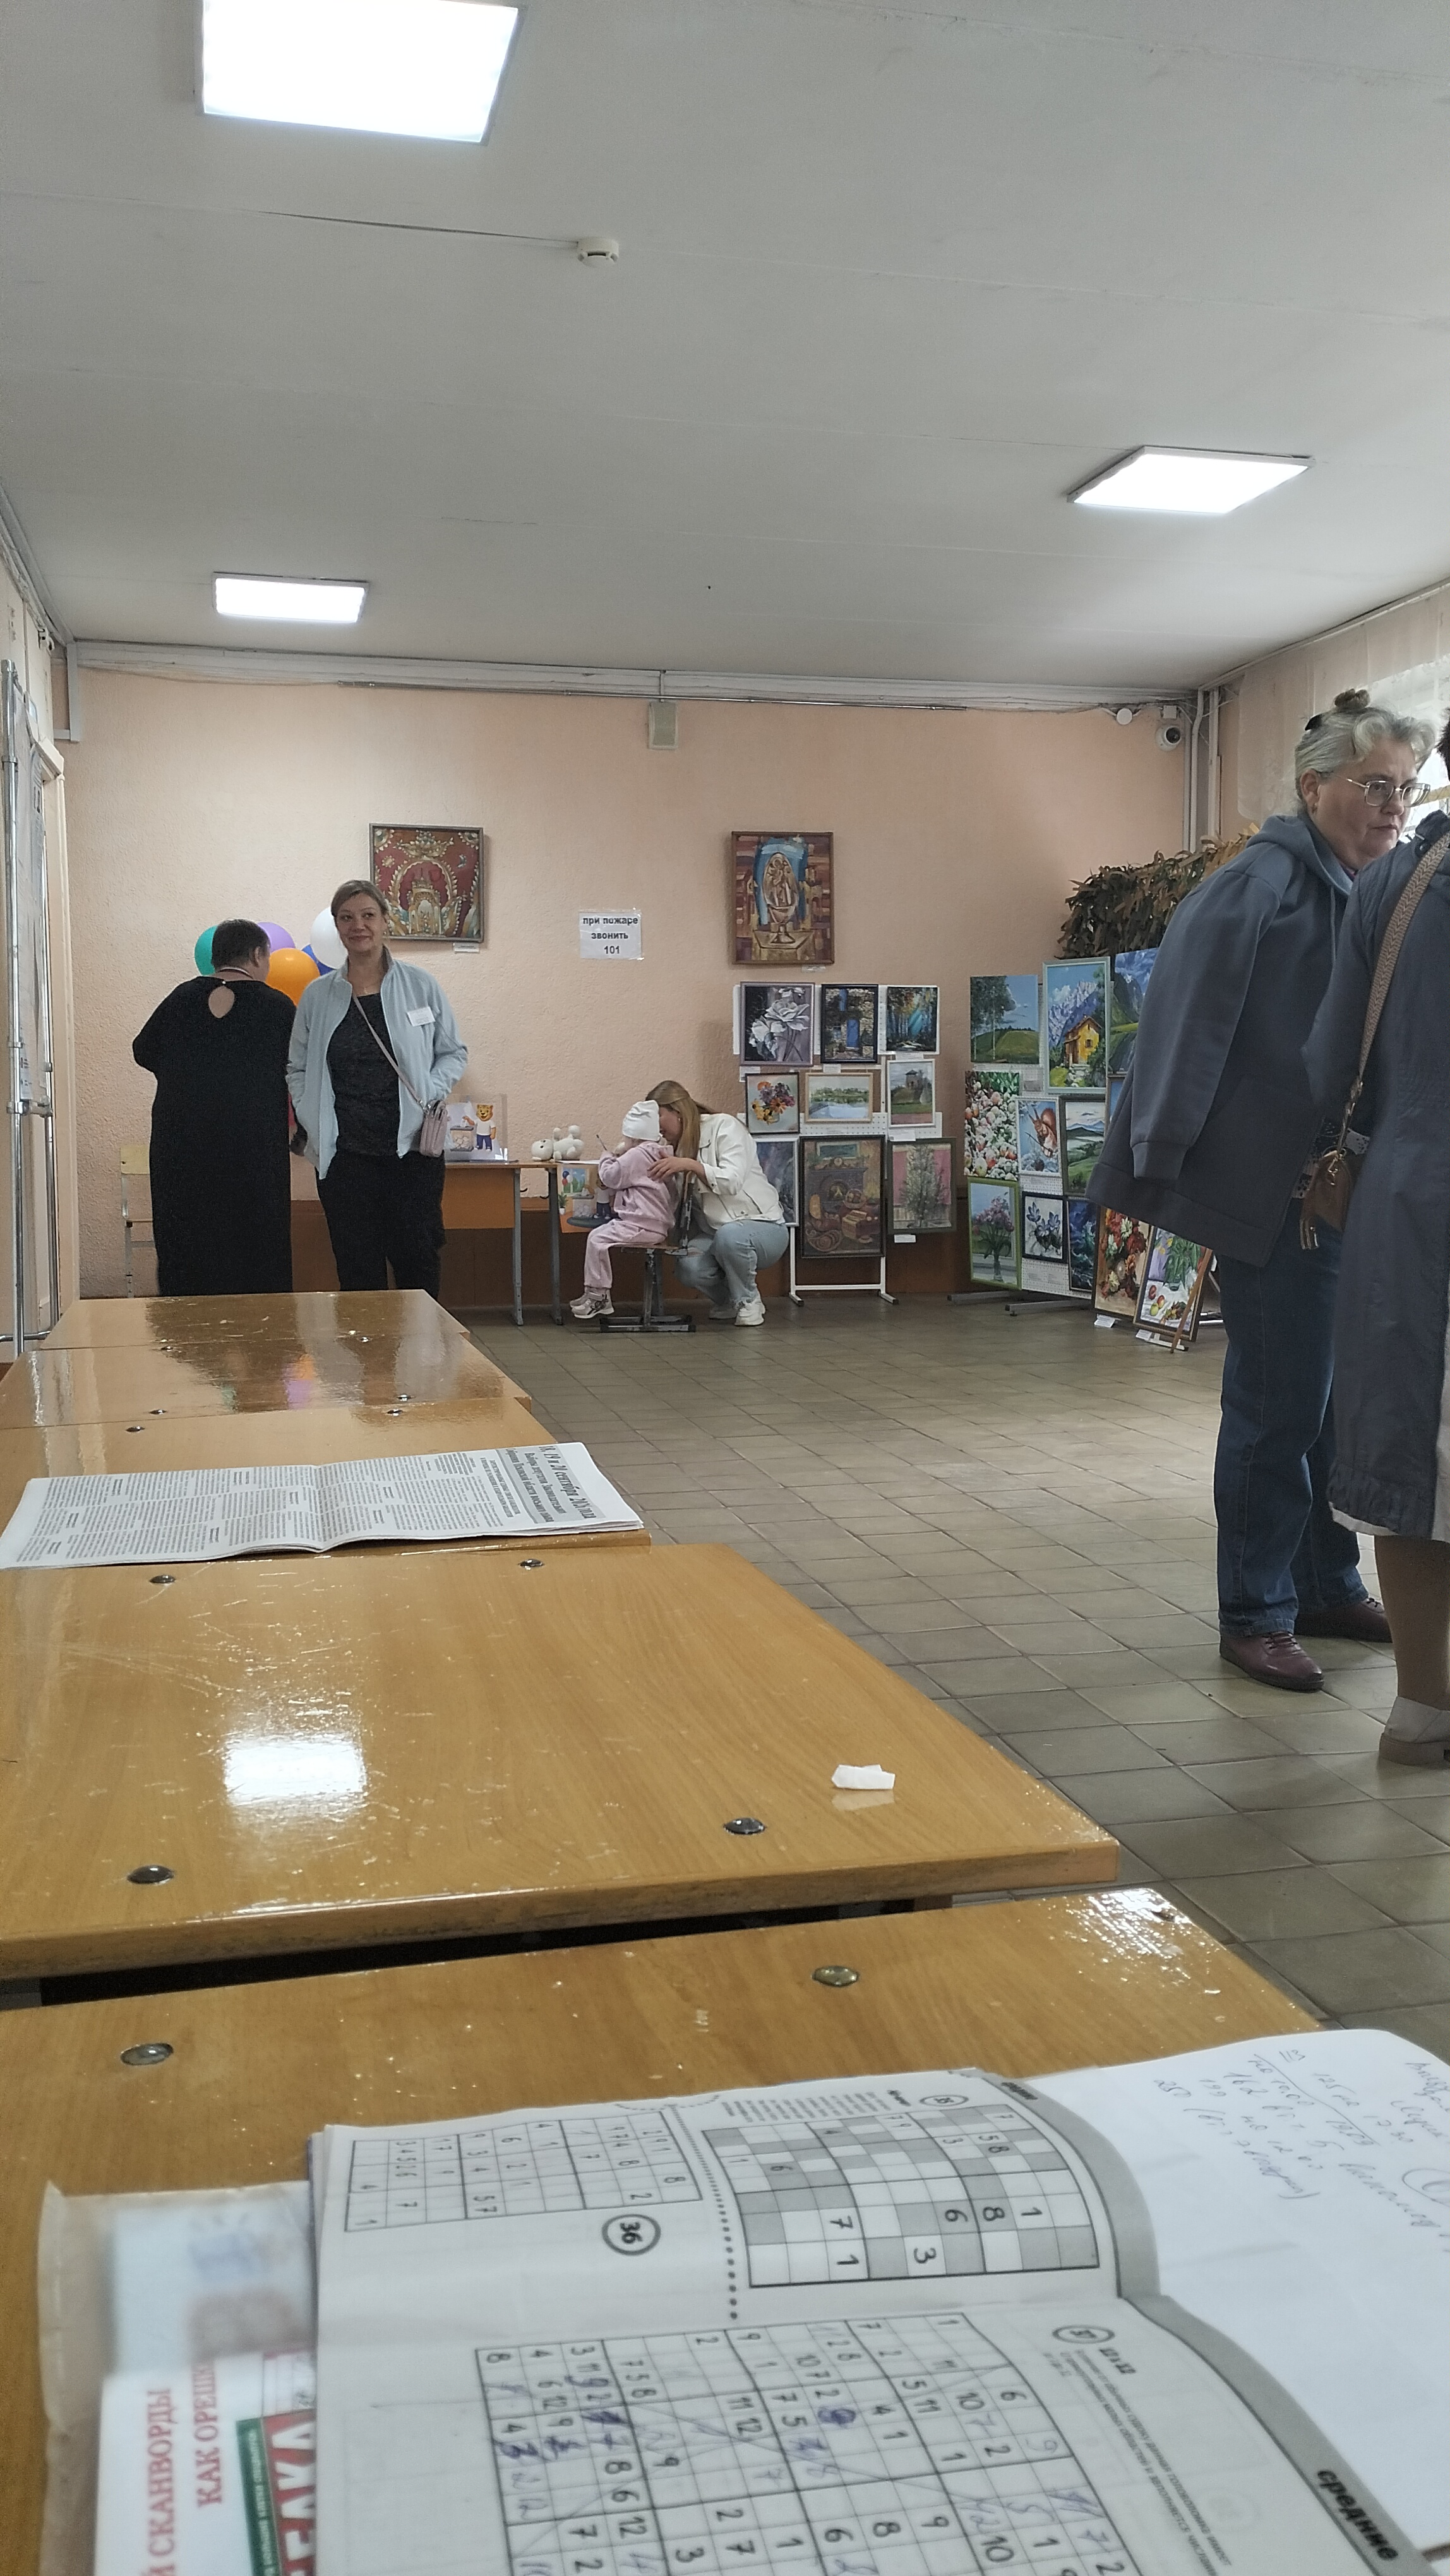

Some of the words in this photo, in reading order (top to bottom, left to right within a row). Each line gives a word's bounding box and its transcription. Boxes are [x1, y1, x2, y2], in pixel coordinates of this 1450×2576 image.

[583, 917, 600, 926] при
[603, 917, 638, 926] пожаре
[604, 946, 620, 954] 101
[554, 1472, 580, 1496] сентября
[945, 2209, 968, 2222] 6
[983, 2207, 1005, 2221] 8
[1021, 2207, 1043, 2217] 1
[830, 2215, 853, 2229] 7
[620, 2222, 643, 2244] 36
[837, 2254, 859, 2265] 1
[913, 2247, 937, 2263] 3
[571, 2346, 595, 2355] 3
[538, 2380, 563, 2388] 6
[902, 2380, 927, 2390] 5
[486, 2353, 511, 2363] 8
[503, 2424, 527, 2433] 4
[772, 2393, 798, 2402] 7
[542, 2396, 568, 2410] 12
[728, 2397, 754, 2410] 11
[914, 2399, 942, 2413] 11
[548, 2418, 573, 2427] 9
[736, 2418, 762, 2436] 12
[781, 2415, 807, 2428] 5
[796, 2354, 821, 2368] 10
[815, 2388, 840, 2398] 2
[873, 2522, 901, 2538] 8
[941, 2453, 967, 2462] 1
[147, 2389, 177, 2556] СКАНВОРДЫ
[605, 2462, 632, 2474] 8
[956, 2392, 985, 2410] 10
[985, 2445, 1010, 2457] 2
[1033, 2537, 1060, 2548] 1
[195, 2447, 222, 2508] КАК
[632, 2388, 656, 2398] 8
[653, 2457, 680, 2467] 9
[675, 2548, 704, 2563] 3
[883, 2431, 908, 2439] 1
[921, 2516, 949, 2527] 9
[1000, 2392, 1027, 2401] 6
[1096, 2562, 1125, 2575] 2
[612, 2490, 640, 2502] 6
[716, 2509, 743, 2522] 2
[1317, 2470, 1399, 2561] средние
[568, 2525, 598, 2537] 7
[620, 2517, 647, 2539] 12
[776, 2537, 803, 2548] 1
[824, 2528, 854, 2543] 6
[726, 2539, 756, 2555] 7
[981, 2536, 1014, 2562] 10
[575, 2559, 602, 2573] 2
